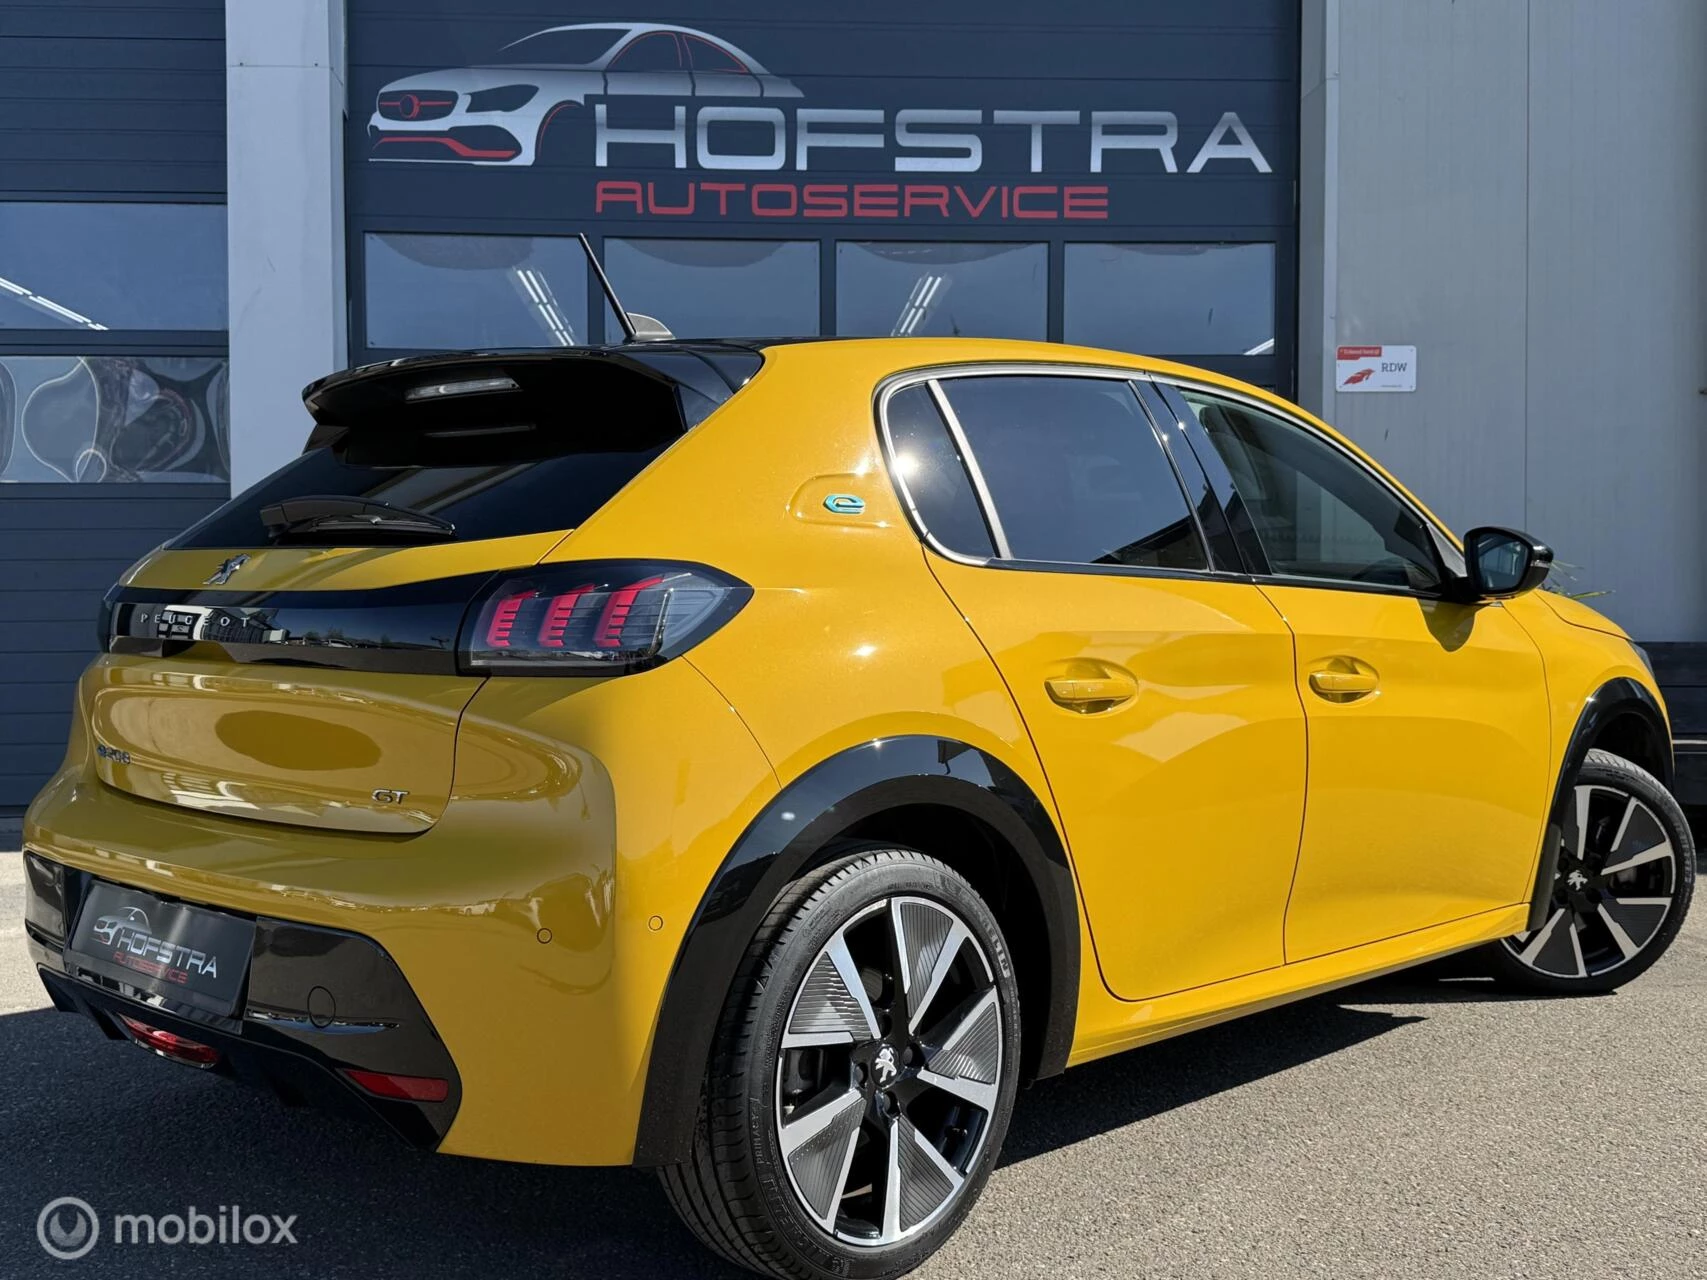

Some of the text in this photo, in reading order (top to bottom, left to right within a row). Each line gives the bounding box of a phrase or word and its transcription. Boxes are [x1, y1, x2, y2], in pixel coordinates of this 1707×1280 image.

[594, 104, 1273, 174] HOFSTRA
[594, 181, 1109, 220] AUTOSERVICE
[1381, 362, 1407, 373] RDW
[140, 612, 251, 628] PEUGEOT
[371, 789, 409, 804] GT
[116, 928, 217, 979] HOFSTRA
